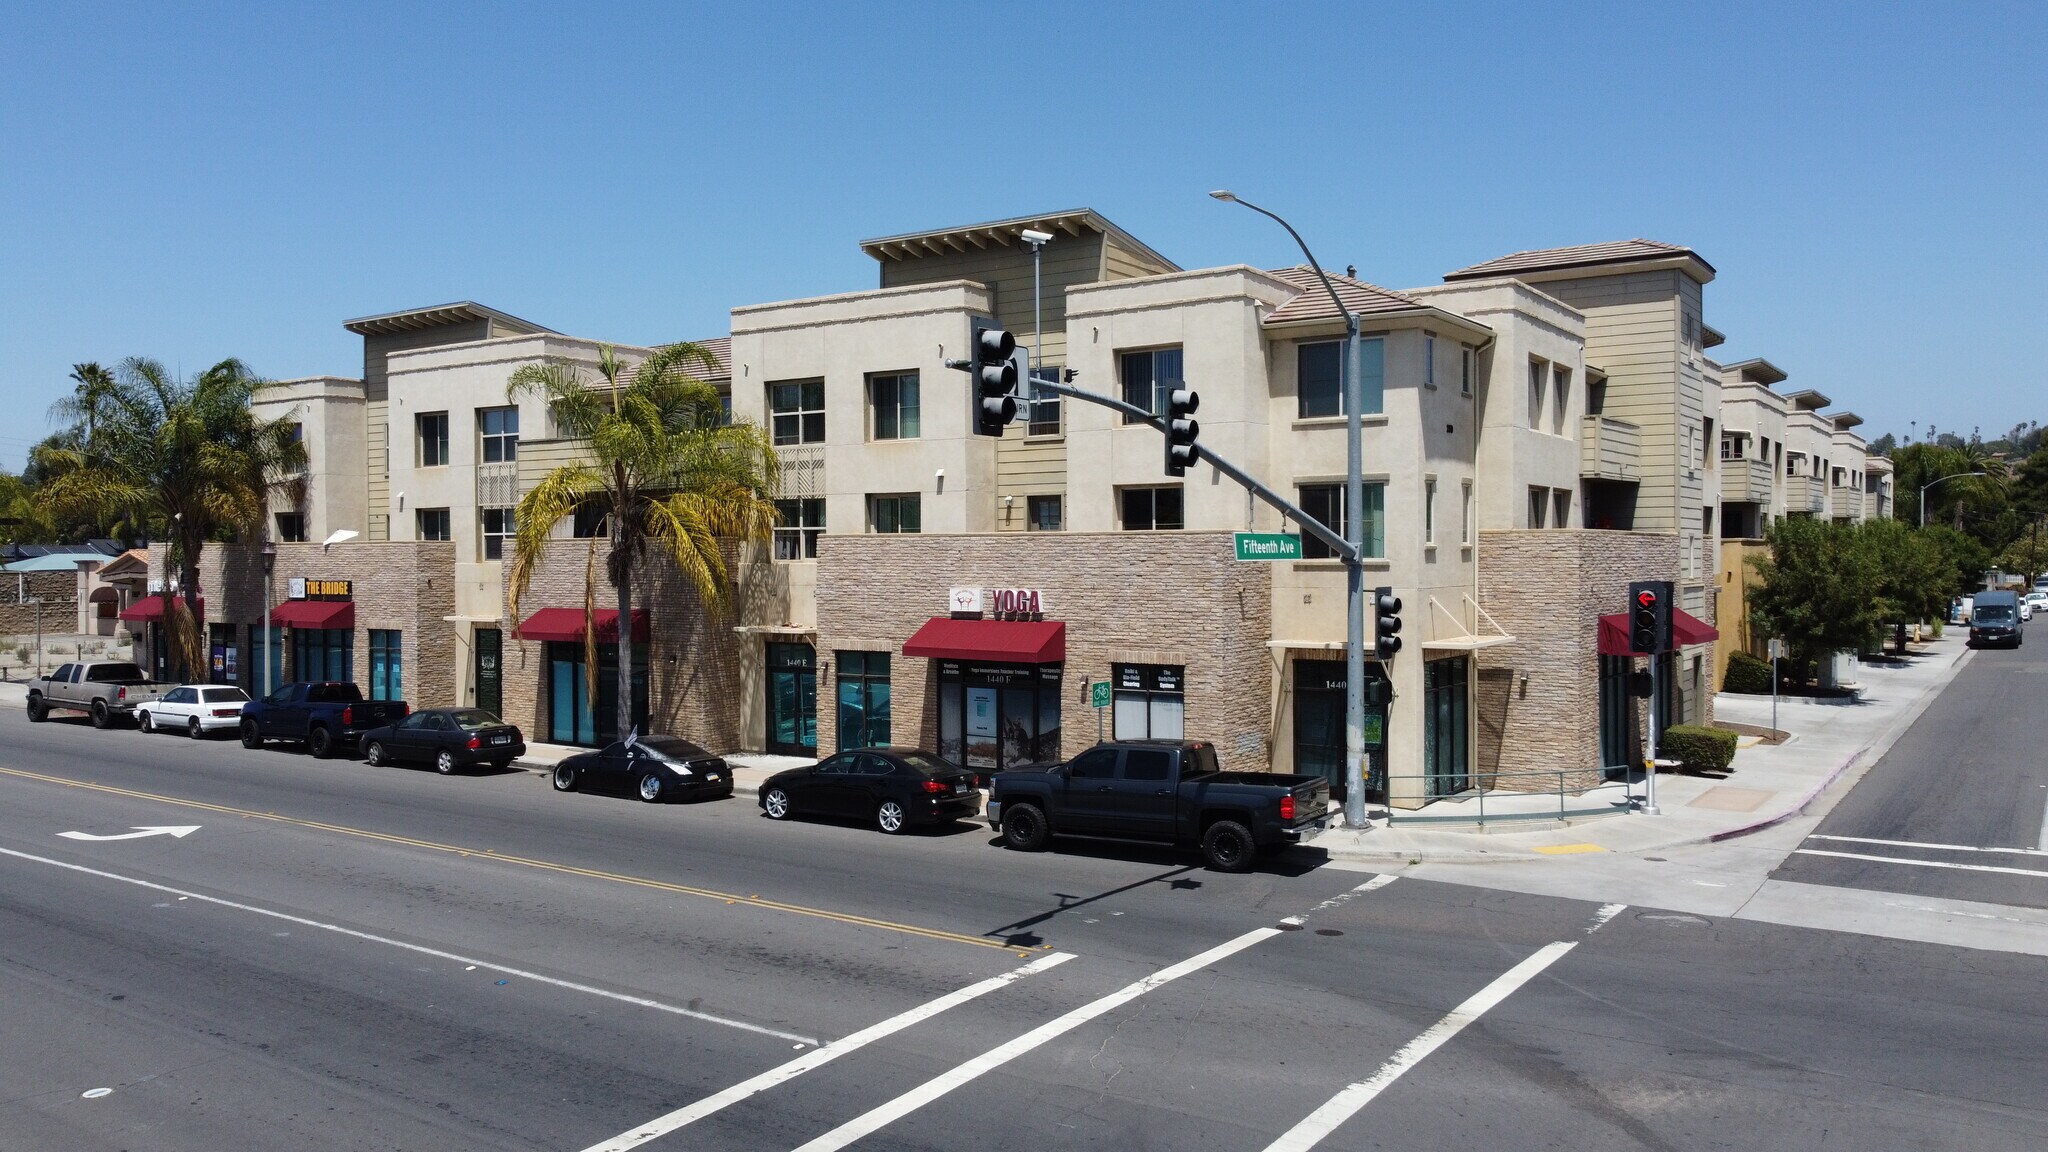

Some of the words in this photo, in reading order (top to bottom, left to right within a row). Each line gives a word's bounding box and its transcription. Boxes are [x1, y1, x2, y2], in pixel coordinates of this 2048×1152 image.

[1243, 539, 1278, 554] Fifteenth
[1280, 540, 1295, 554] Ave
[306, 581, 320, 595] THE
[321, 581, 348, 595] BRIDGE
[992, 589, 1040, 613] YOGA
[987, 675, 1004, 683] 1440
[1326, 680, 1347, 689] 1440
